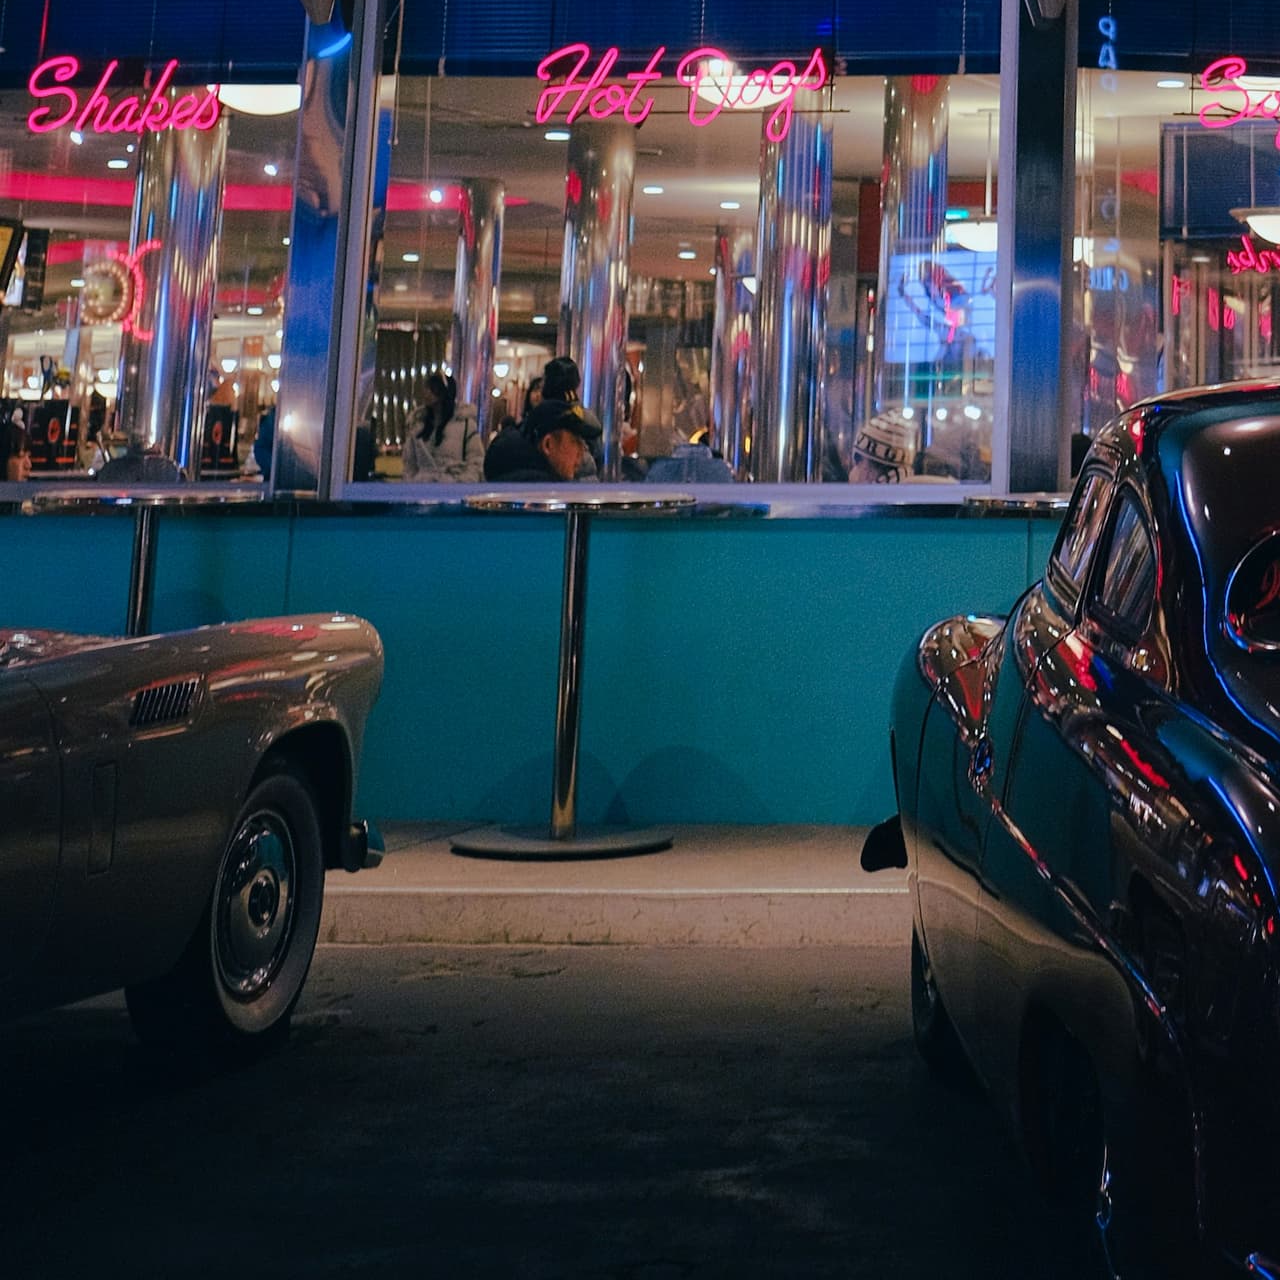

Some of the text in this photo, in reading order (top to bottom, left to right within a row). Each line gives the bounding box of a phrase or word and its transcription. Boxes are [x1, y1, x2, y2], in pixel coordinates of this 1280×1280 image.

[26, 55, 221, 138] Shakes
[535, 43, 829, 144] Hot Dogs
